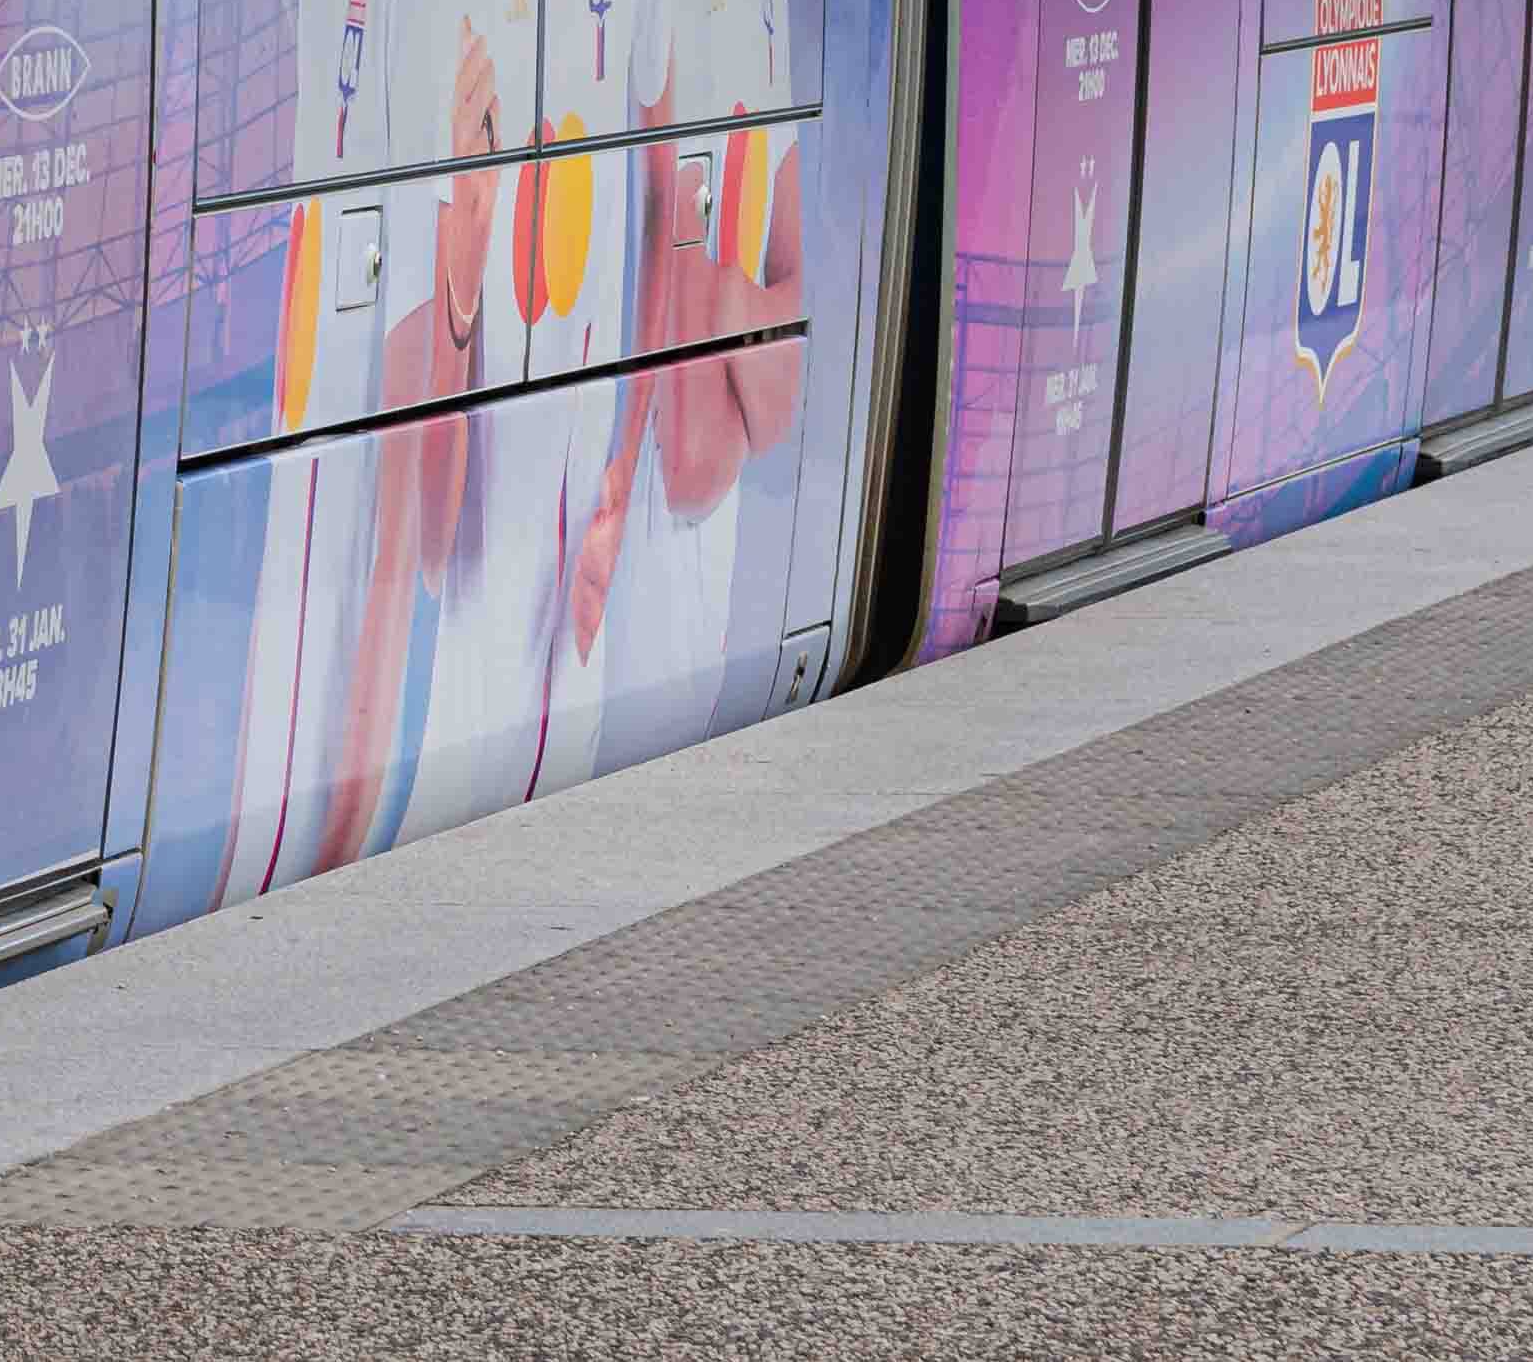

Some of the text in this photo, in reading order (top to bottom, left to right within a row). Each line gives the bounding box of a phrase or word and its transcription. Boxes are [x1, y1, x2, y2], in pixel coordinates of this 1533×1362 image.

[10, 49, 72, 99] BRANN
[1315, 42, 1376, 98] LYONNAIS
[54, 144, 90, 189] DEC.
[13, 198, 64, 245] 21H00
[1306, 140, 1360, 316] OL
[29, 603, 66, 653] JAN.
